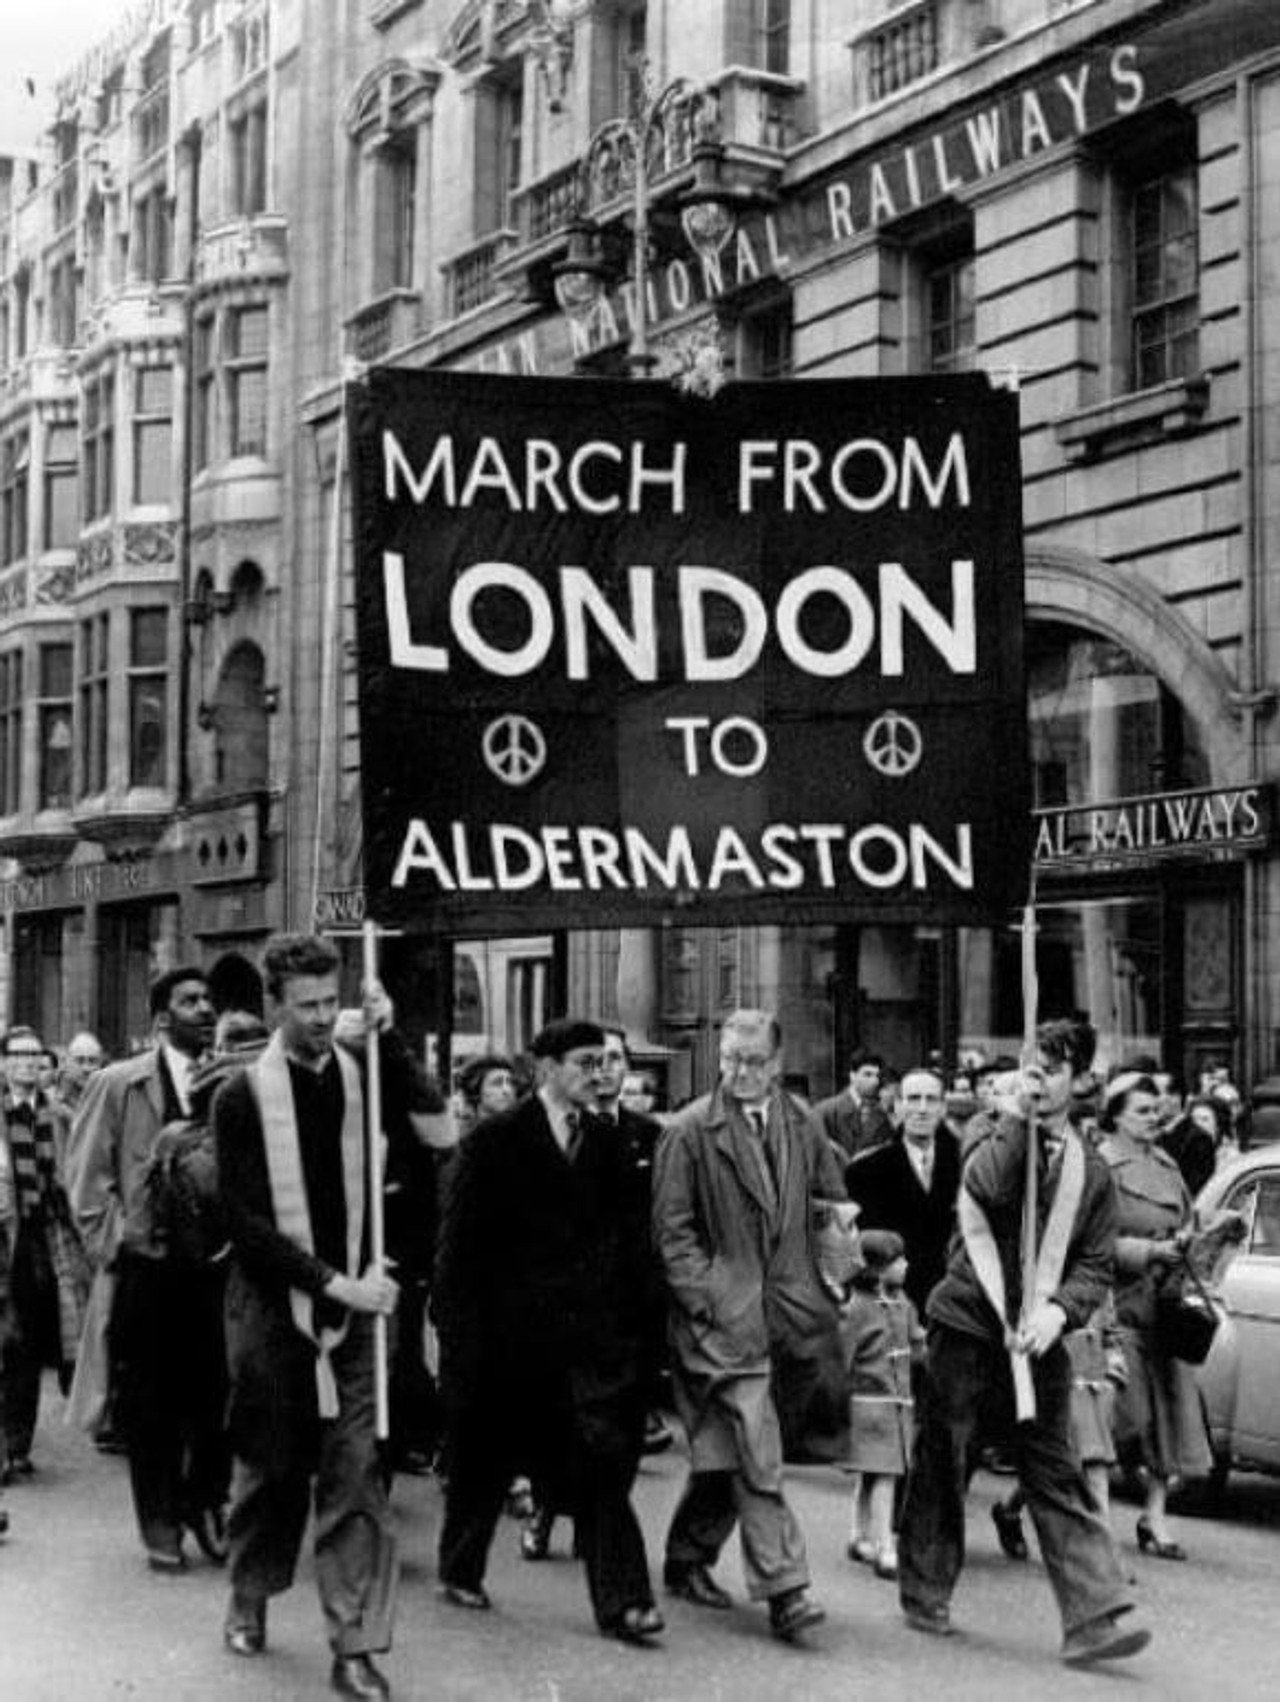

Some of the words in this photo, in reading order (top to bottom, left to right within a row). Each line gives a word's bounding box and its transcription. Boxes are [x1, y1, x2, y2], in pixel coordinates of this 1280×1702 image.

[826, 44, 1144, 240] RAILWAYS
[383, 430, 686, 513] MARCH
[739, 433, 971, 513] FROM
[383, 551, 976, 681] LONDON
[665, 716, 767, 777] TO
[391, 818, 974, 891] ALDERMASTON
[1091, 789, 1259, 853] RAILWAYS
